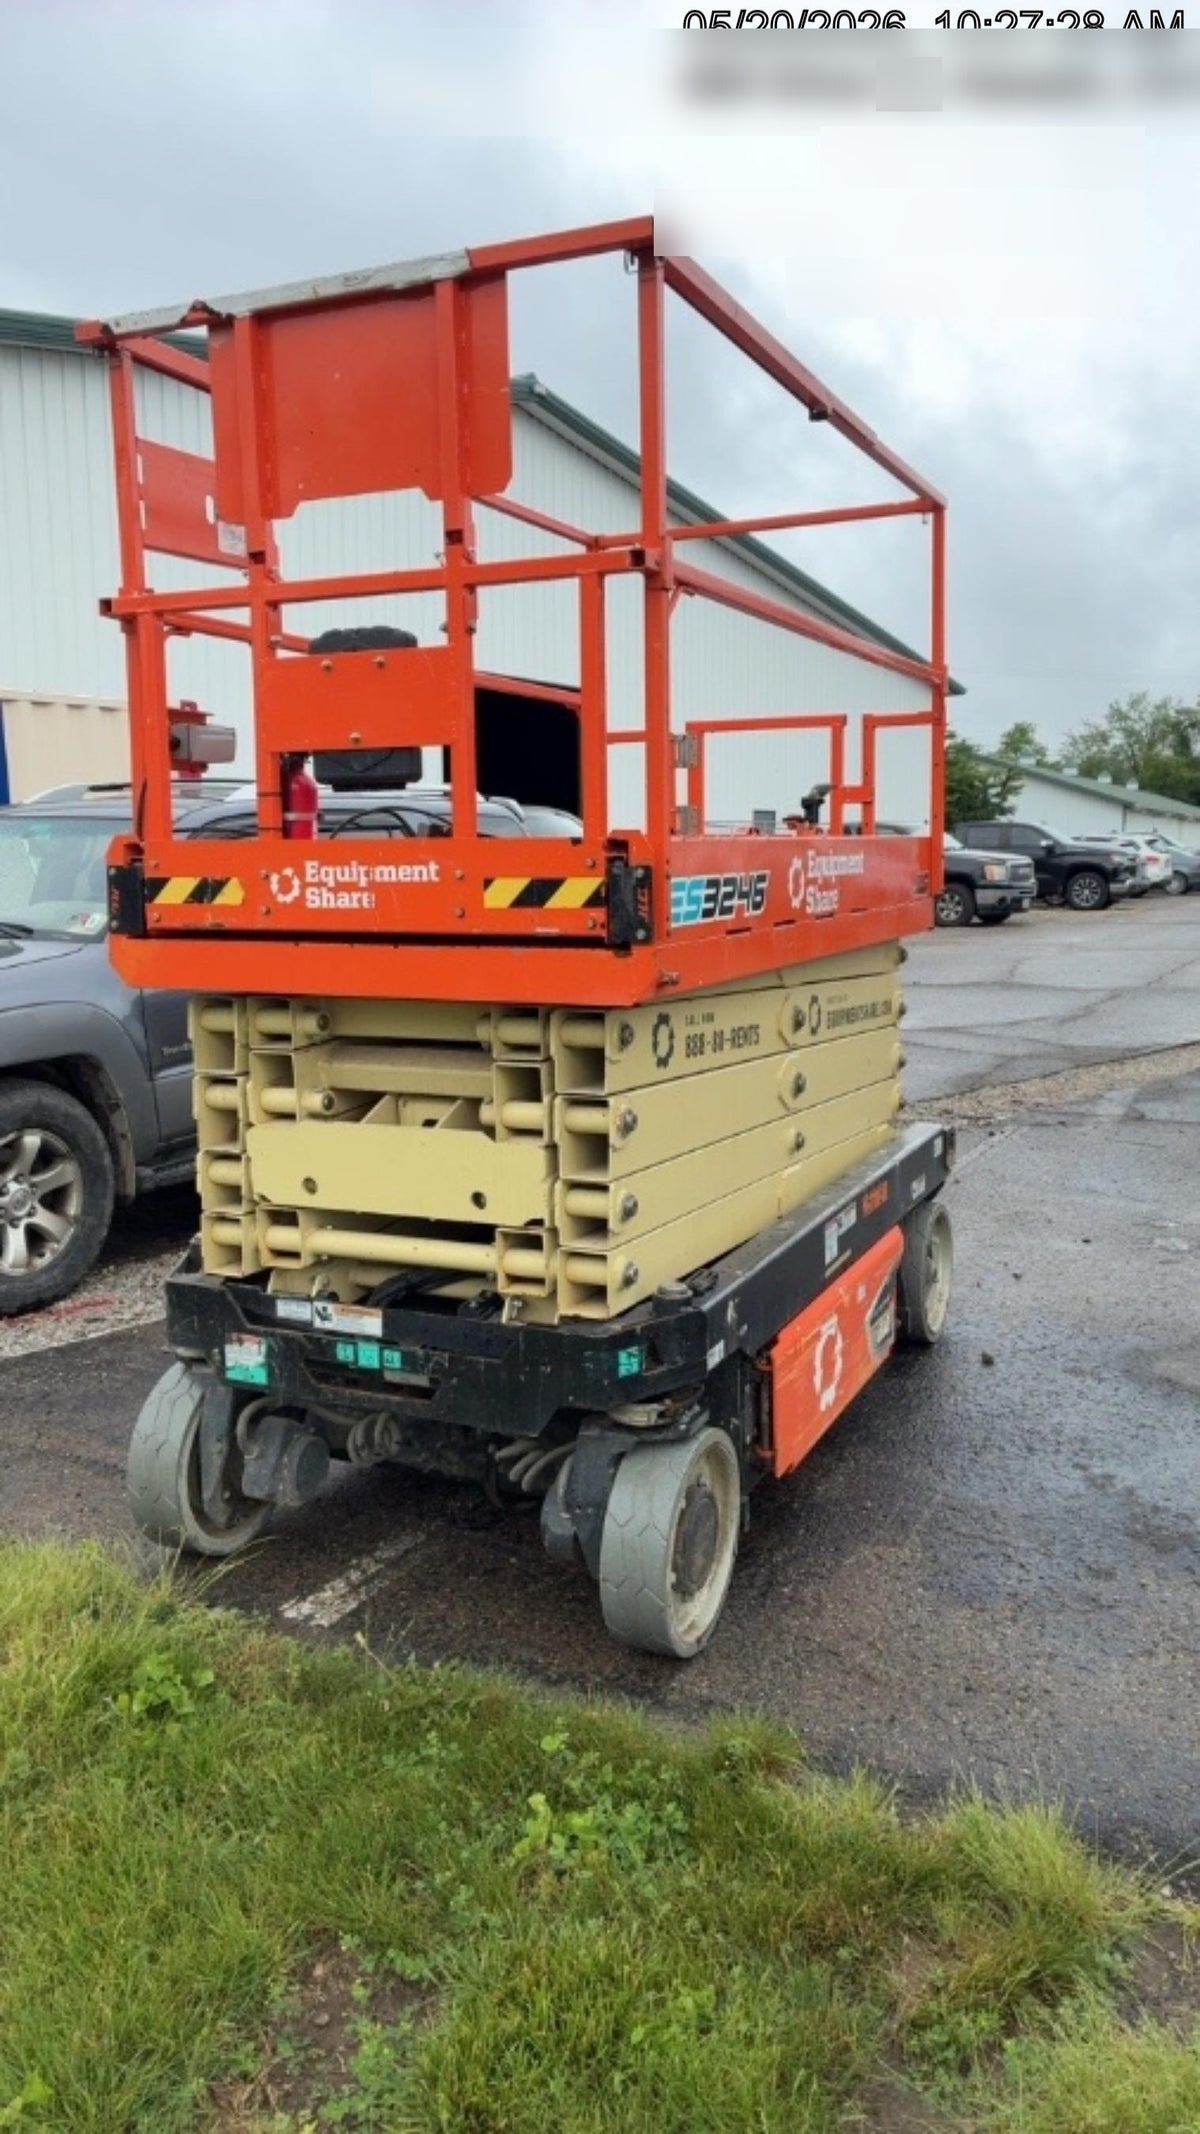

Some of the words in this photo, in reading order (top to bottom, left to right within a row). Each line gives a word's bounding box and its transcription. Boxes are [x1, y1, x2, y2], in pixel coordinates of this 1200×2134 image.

[807, 849, 865, 885] Equipment
[670, 870, 770, 928] ES3246
[805, 887, 840, 914] Share
